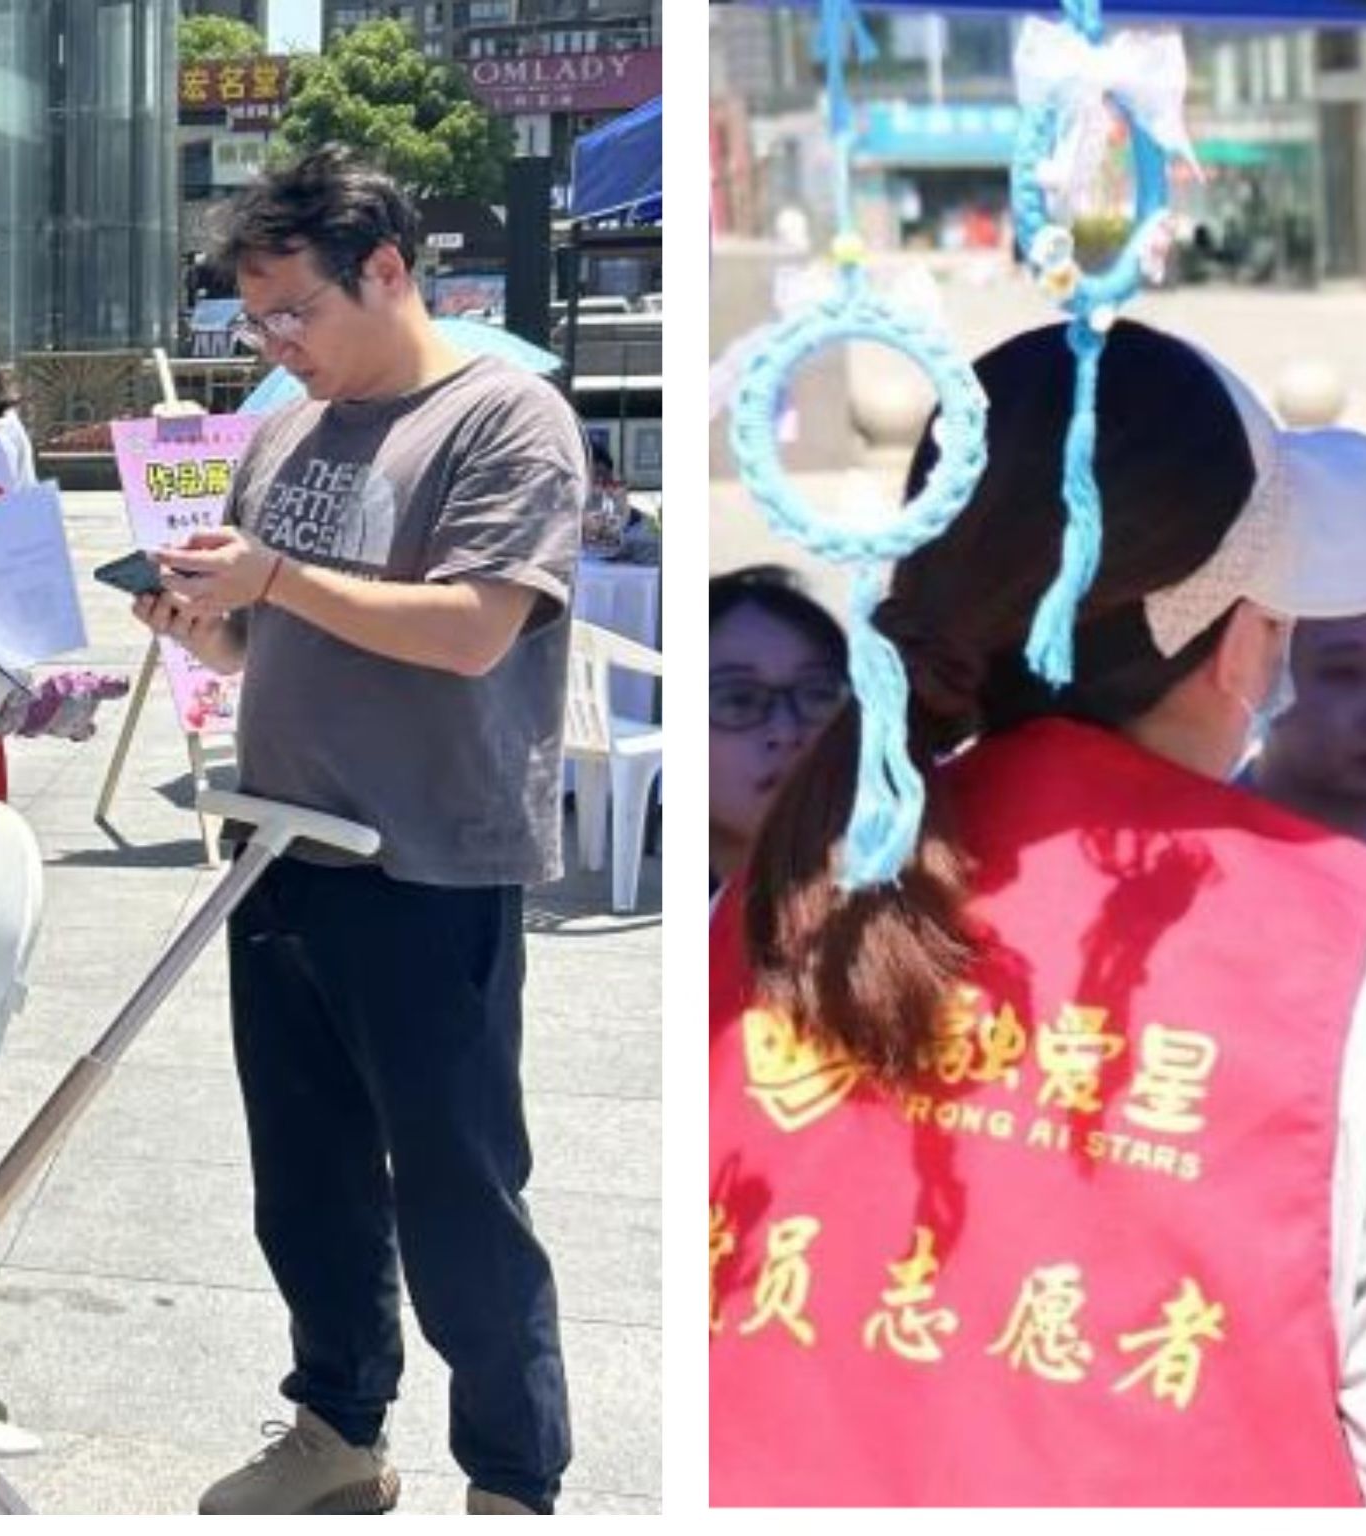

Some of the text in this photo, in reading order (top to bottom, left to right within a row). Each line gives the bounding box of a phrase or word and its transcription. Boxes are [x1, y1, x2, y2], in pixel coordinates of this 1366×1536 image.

[146, 458, 238, 502] 作品展
[906, 1095, 1014, 1140] RONG
[1084, 1130, 1202, 1181] STARS
